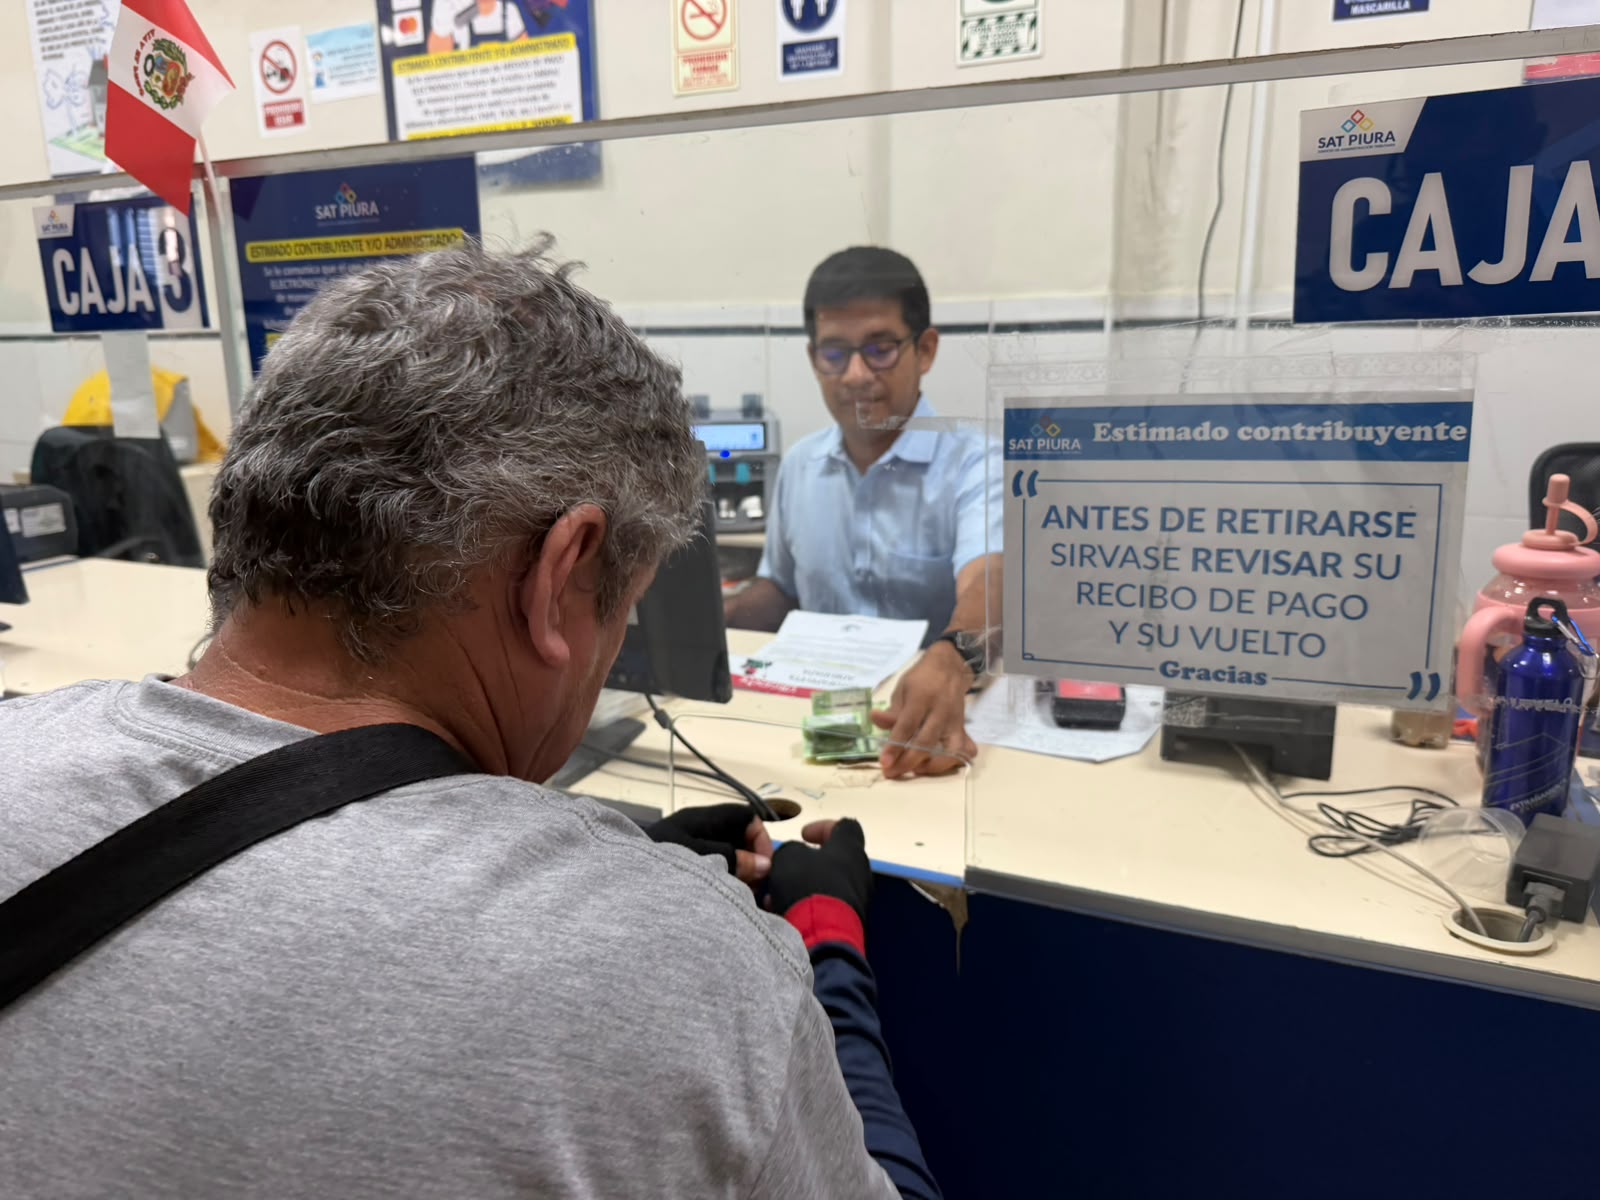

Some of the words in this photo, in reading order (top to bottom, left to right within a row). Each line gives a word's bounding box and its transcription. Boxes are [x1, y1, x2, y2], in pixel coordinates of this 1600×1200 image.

[1350, 0, 1410, 16] MASCARILLA
[1318, 135, 1345, 149] SAT
[1348, 130, 1396, 146] PIURA
[315, 204, 337, 219] SAT
[340, 201, 379, 217] PIURA
[1329, 160, 1600, 291] CAJA
[250, 243, 293, 258] ESTIMADO
[294, 239, 365, 256] CONTRIBUYENTE
[366, 237, 383, 251] Y/O
[53, 243, 156, 316] CAJA
[158, 227, 192, 313] 3
[1008, 438, 1033, 451] SAT
[1037, 437, 1081, 450] PIURA
[1093, 421, 1229, 442] Estimado
[1237, 420, 1467, 446] contribuyente
[1041, 505, 1149, 531] ANTES
[1160, 507, 1206, 533] DE
[1216, 508, 1417, 539] RETIRARSE
[1051, 543, 1181, 571] SIRVASE
[1191, 548, 1343, 578] REVISAR
[1353, 553, 1402, 580] SU
[1077, 581, 1197, 611] RECIBO
[1209, 588, 1255, 614] DE
[1267, 591, 1368, 620] PAGO
[1108, 620, 1129, 644] Y
[1137, 623, 1179, 648] SU
[1189, 626, 1326, 658] VUELTO
[1159, 660, 1267, 686] Gracias
